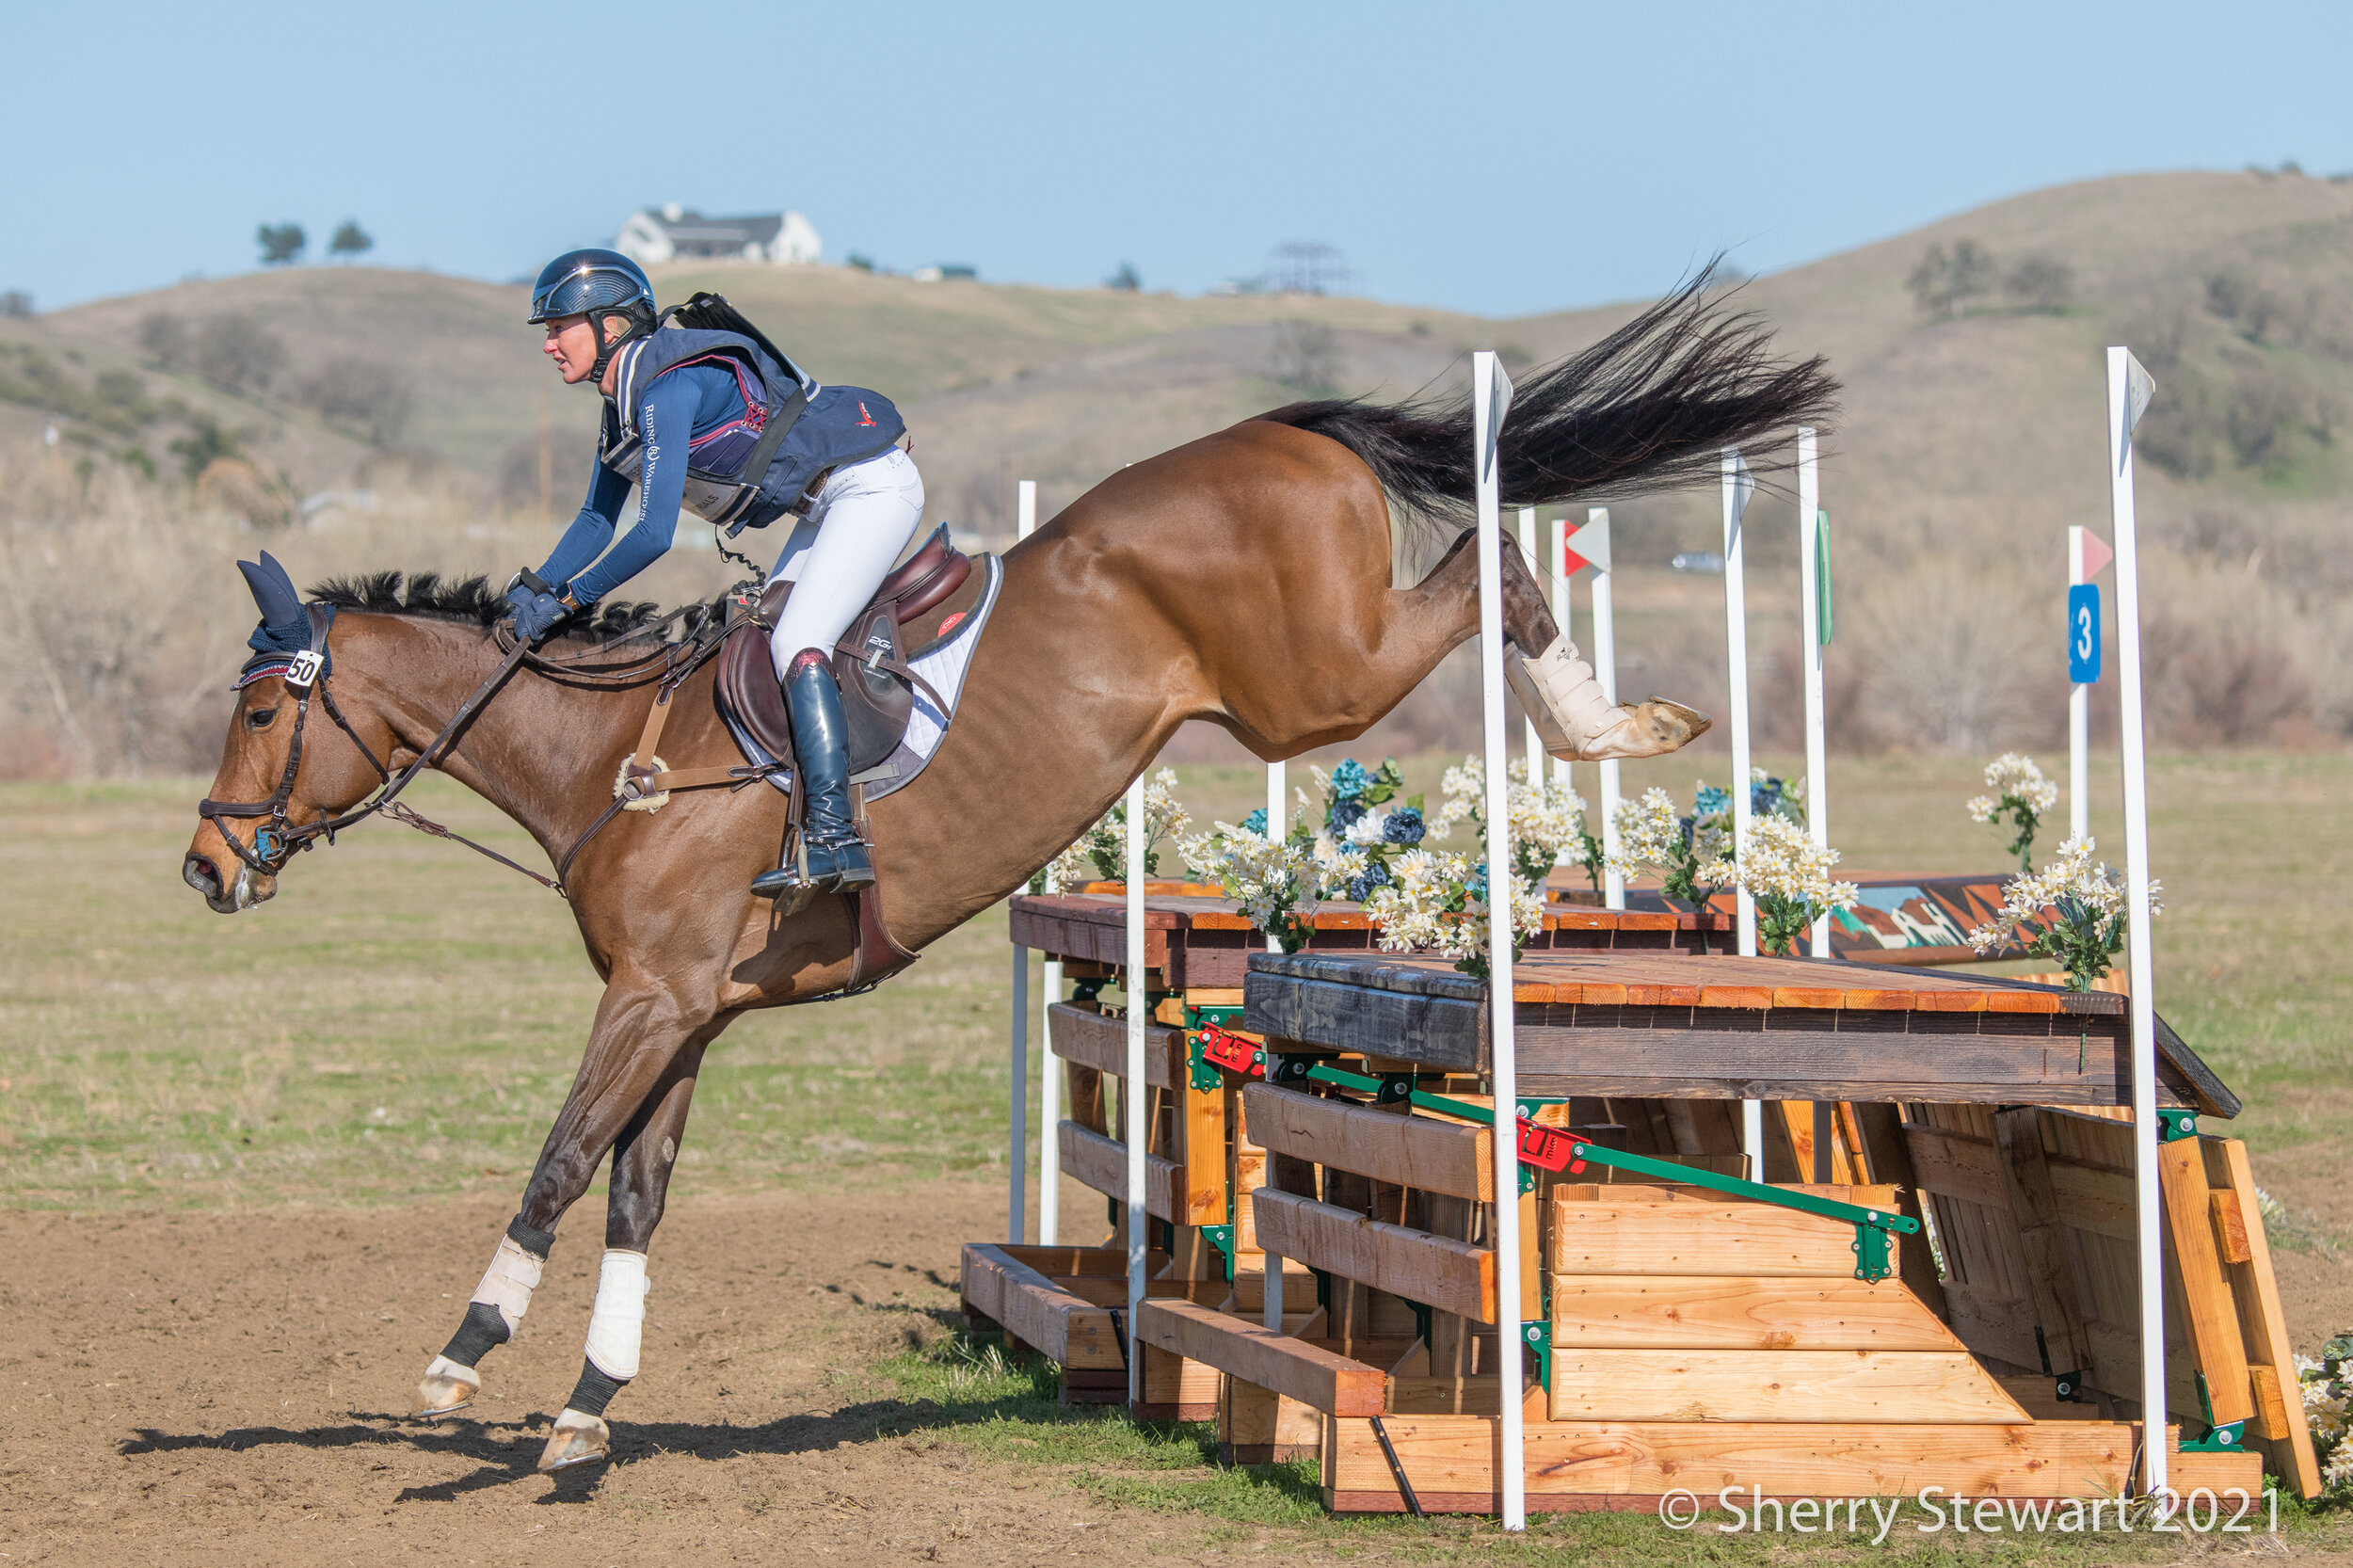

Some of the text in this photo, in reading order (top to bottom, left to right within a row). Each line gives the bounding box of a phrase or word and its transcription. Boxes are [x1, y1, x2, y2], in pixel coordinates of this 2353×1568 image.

[645, 404, 655, 444] RIDING
[2077, 605, 2092, 661] 3
[287, 657, 316, 682] 50
[1546, 1137, 1558, 1160] mim
